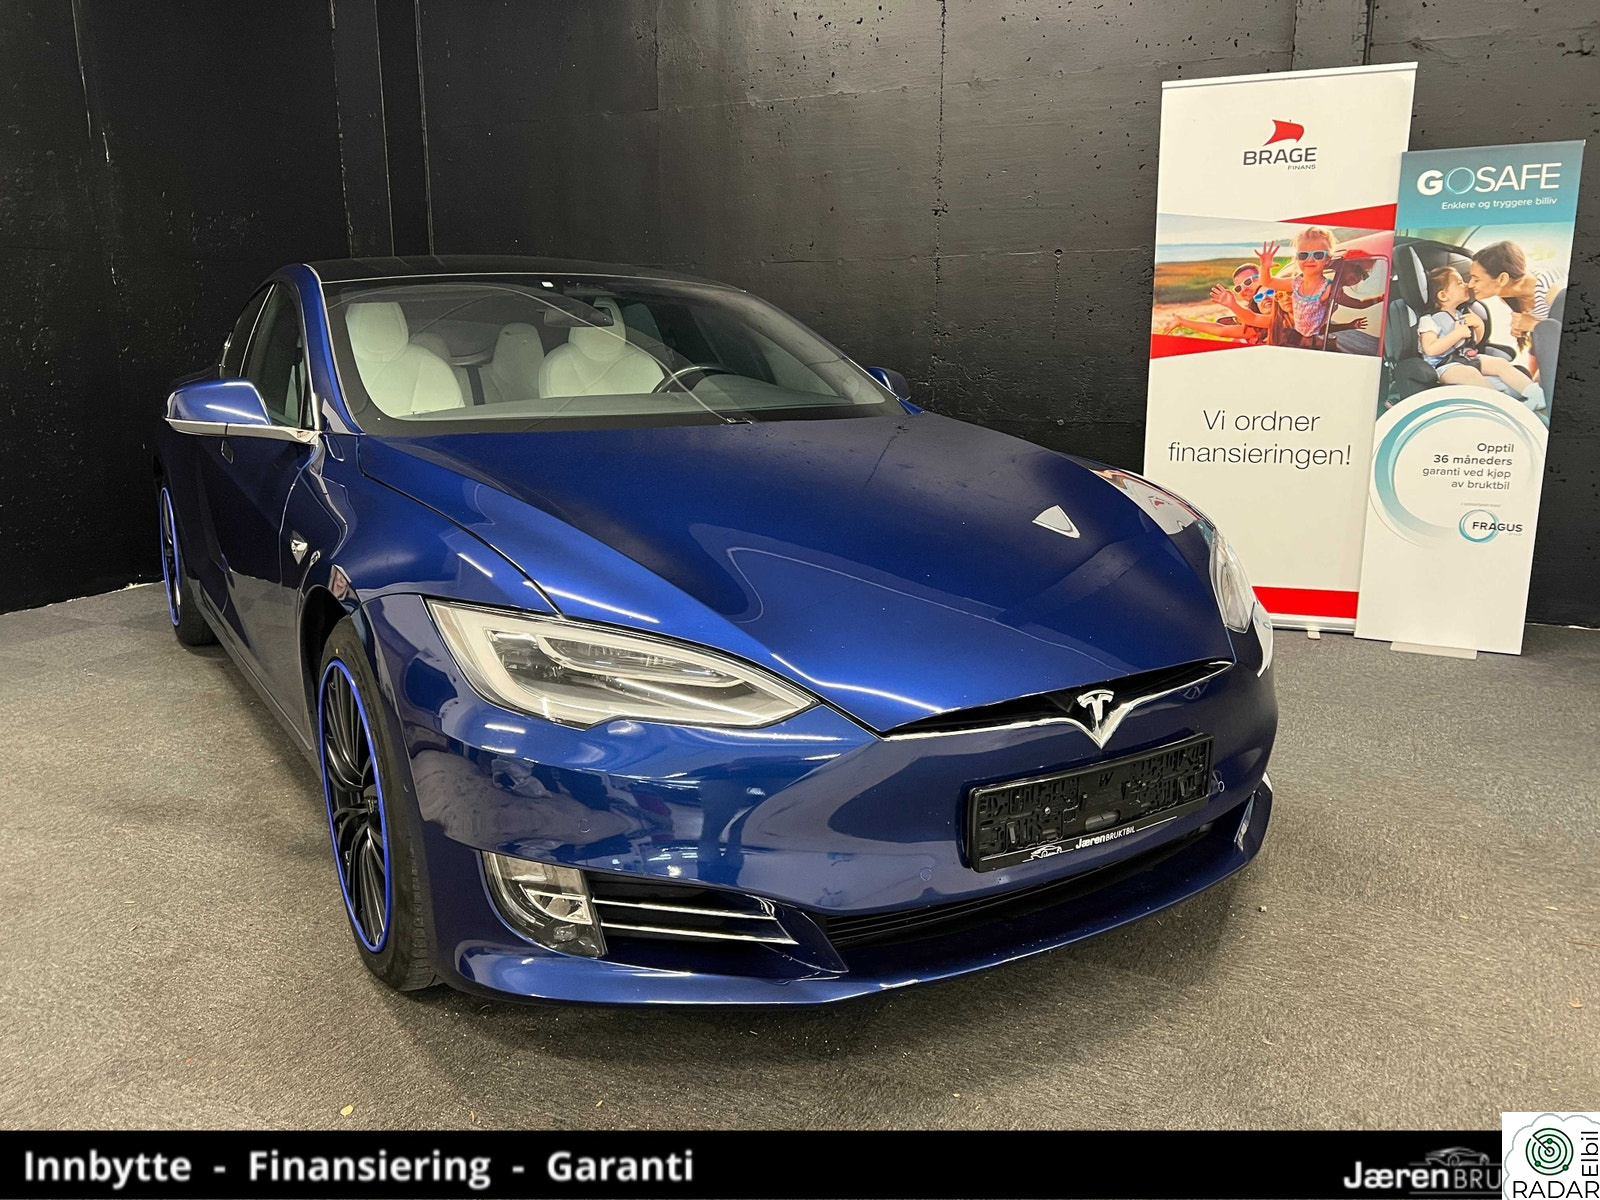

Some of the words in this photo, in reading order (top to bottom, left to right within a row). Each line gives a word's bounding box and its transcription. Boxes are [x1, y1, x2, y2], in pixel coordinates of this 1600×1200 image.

[1243, 147, 1317, 165] BRAGE
[1417, 162, 1562, 196] GOSAFE
[1441, 201, 1476, 210] Enklere
[1478, 201, 1491, 210] og
[1493, 199, 1533, 208] tryggere
[1535, 197, 1558, 205] billiv
[1203, 410, 1226, 430] Vi
[1235, 411, 1321, 431] ordner
[1477, 442, 1515, 454] Opptil
[1168, 441, 1351, 470] finansieringen!
[1433, 454, 1449, 463] 36
[1452, 454, 1513, 466] måneders
[1422, 467, 1460, 477] garanti
[1463, 468, 1484, 477] ved
[1487, 468, 1512, 479] kjøp
[1467, 480, 1510, 490] bruktbil
[1472, 521, 1523, 533] FRAGUS
